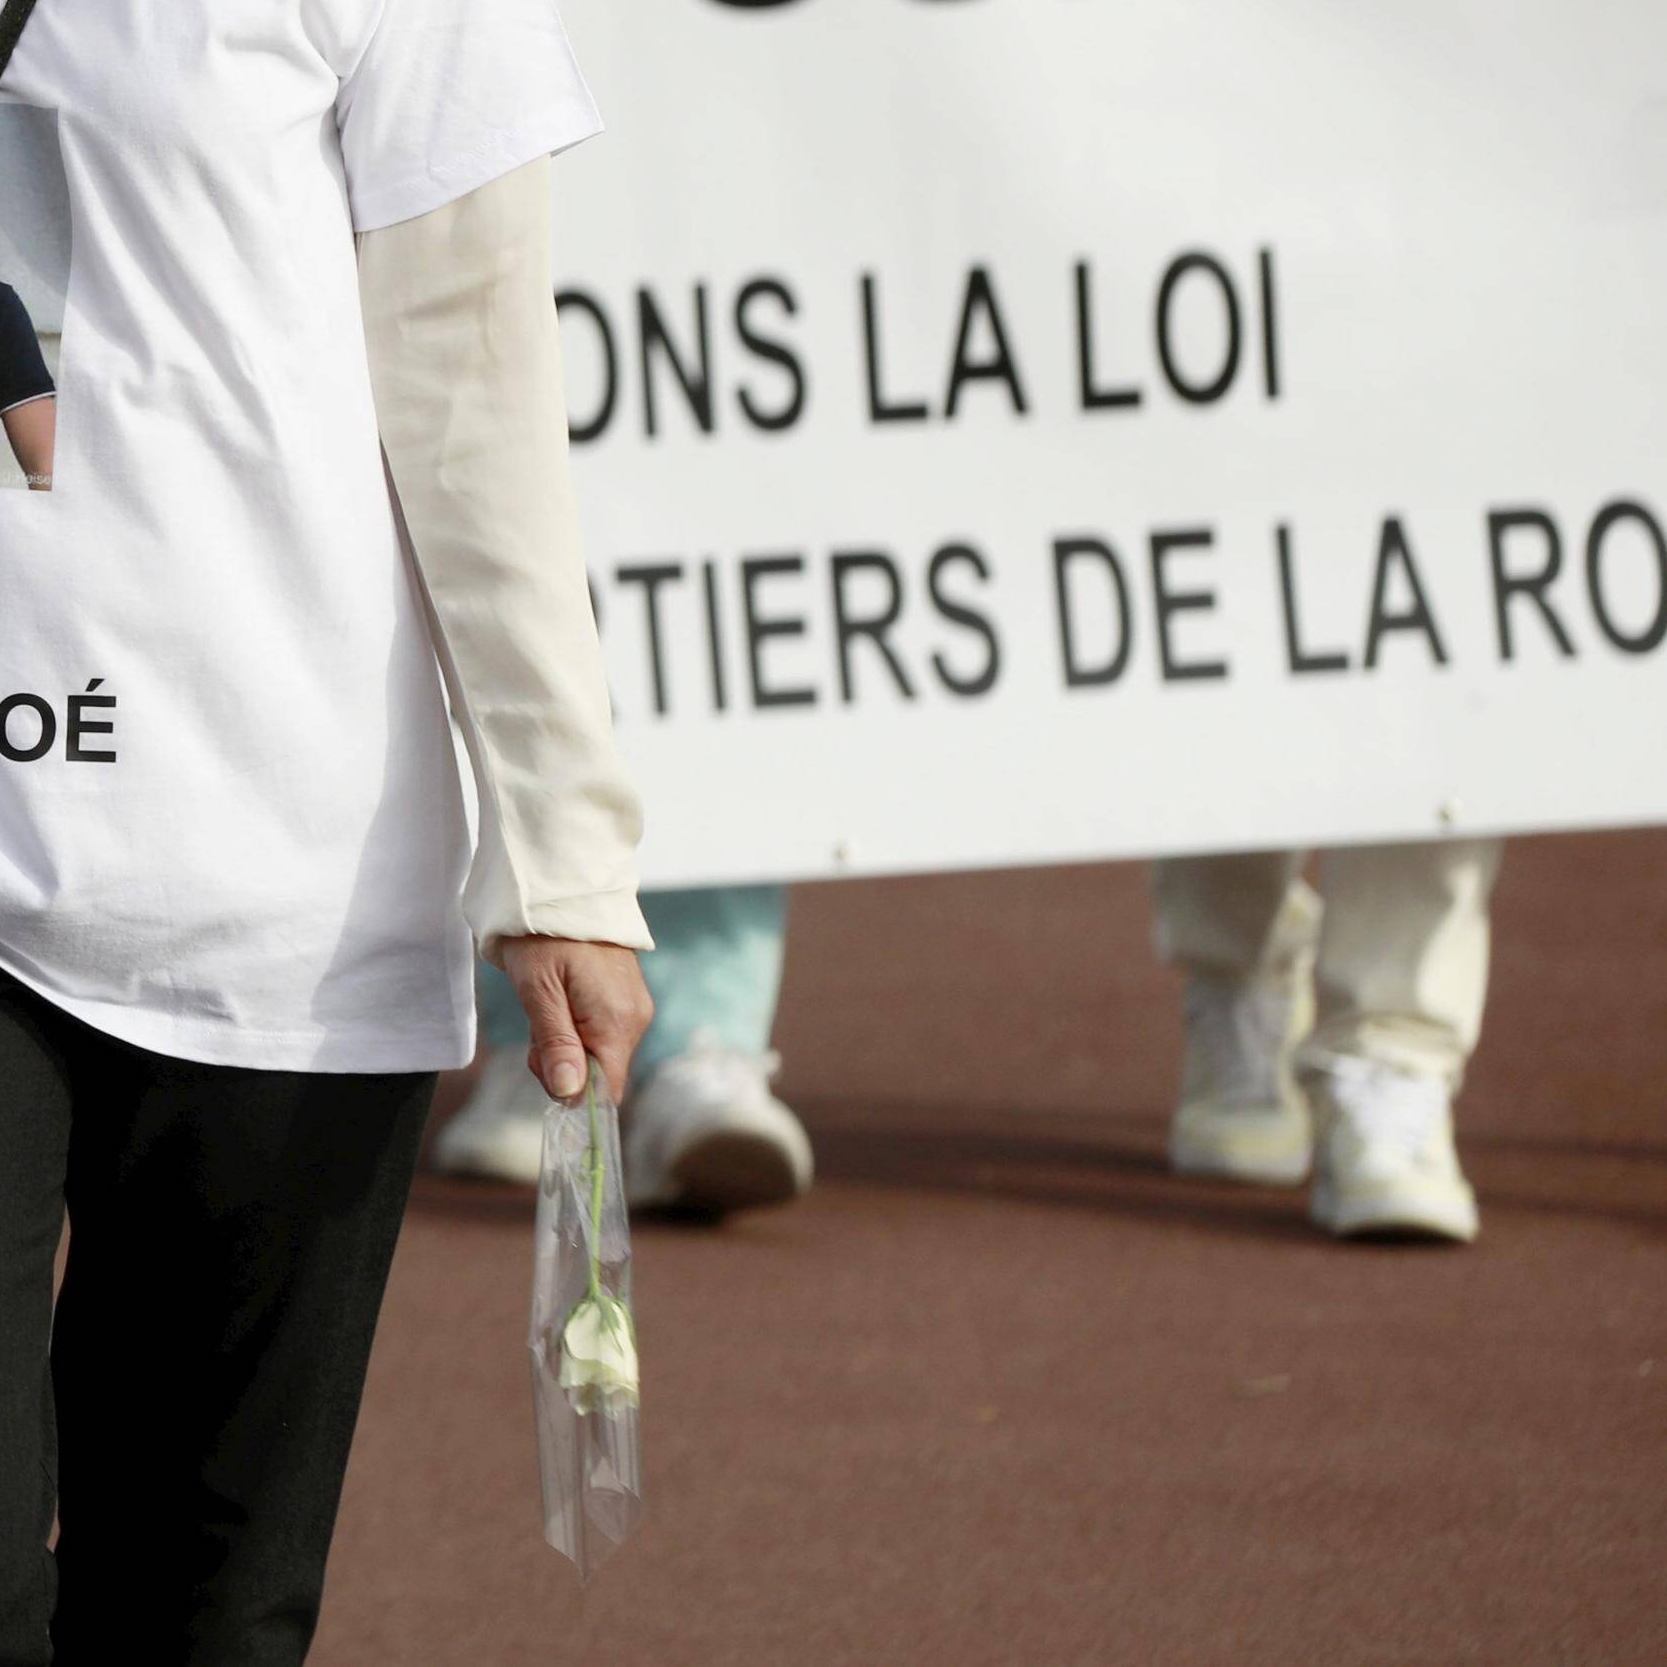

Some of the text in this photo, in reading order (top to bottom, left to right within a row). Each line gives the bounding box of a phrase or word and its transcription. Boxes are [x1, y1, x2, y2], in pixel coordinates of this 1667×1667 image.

[553, 242, 1283, 448] ONS LA LOI
[588, 543, 1003, 718] TIERS
[1052, 527, 1232, 691] DE
[1276, 514, 1451, 675] LA
[1487, 498, 1667, 664] RO
